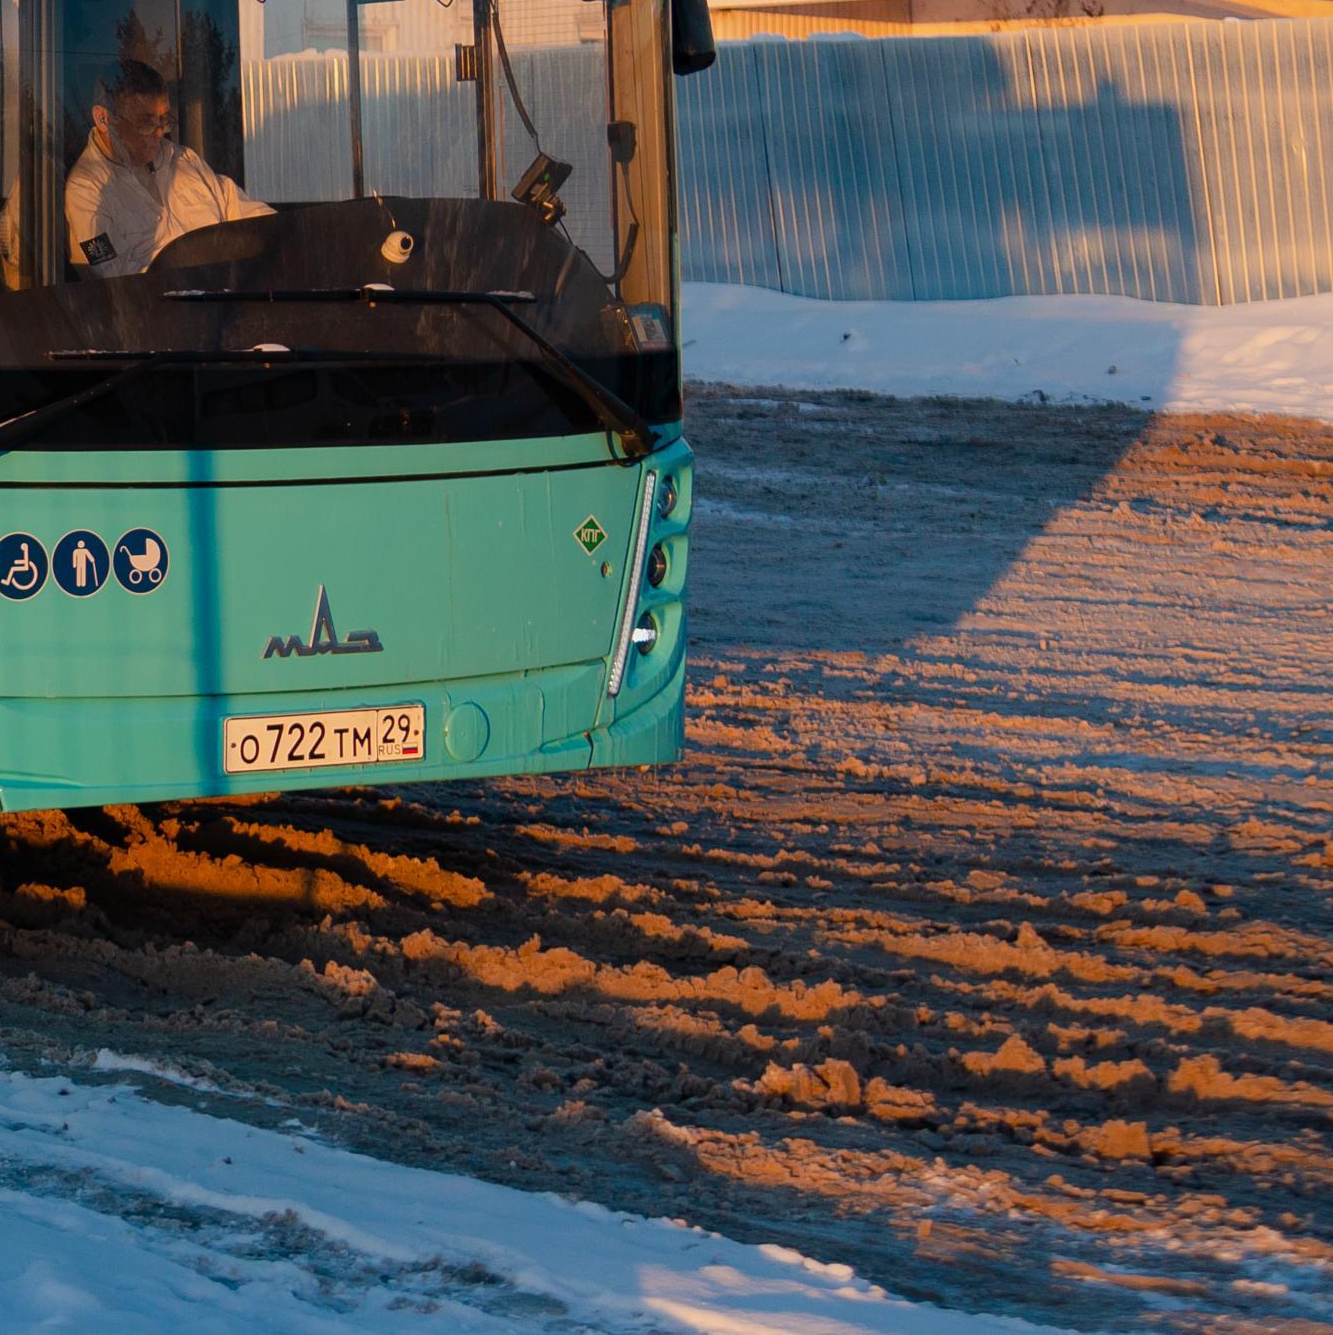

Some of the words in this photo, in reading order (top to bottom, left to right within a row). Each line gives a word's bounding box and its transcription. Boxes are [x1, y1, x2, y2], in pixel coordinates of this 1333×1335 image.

[582, 528, 601, 543] КПГ
[382, 714, 411, 744] 29
[378, 744, 401, 756] RUS
